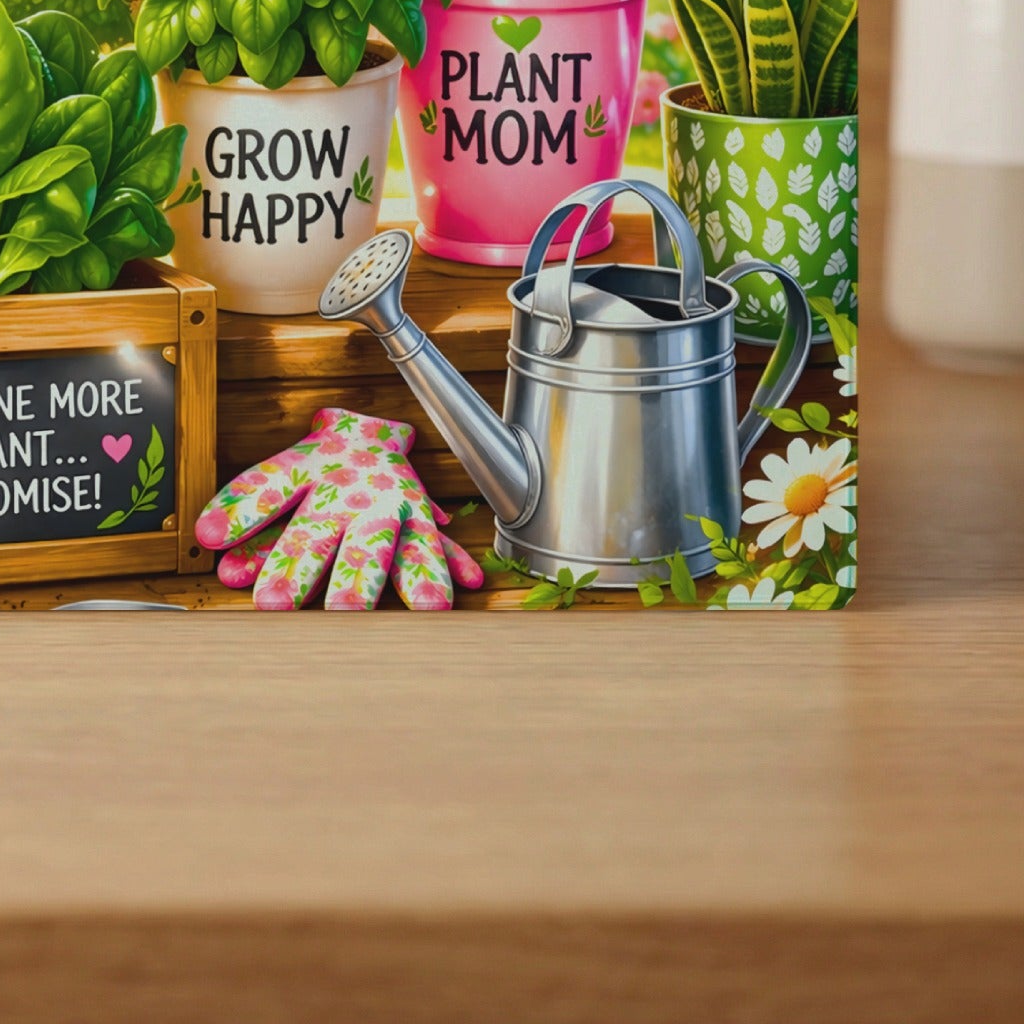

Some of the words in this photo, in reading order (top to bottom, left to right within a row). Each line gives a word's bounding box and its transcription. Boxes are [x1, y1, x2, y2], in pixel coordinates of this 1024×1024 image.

[440, 49, 592, 103] PLANT
[204, 124, 351, 182] GROW
[442, 107, 578, 166] MOM
[201, 187, 353, 245] HAPPY
[49, 378, 144, 420] MORE
